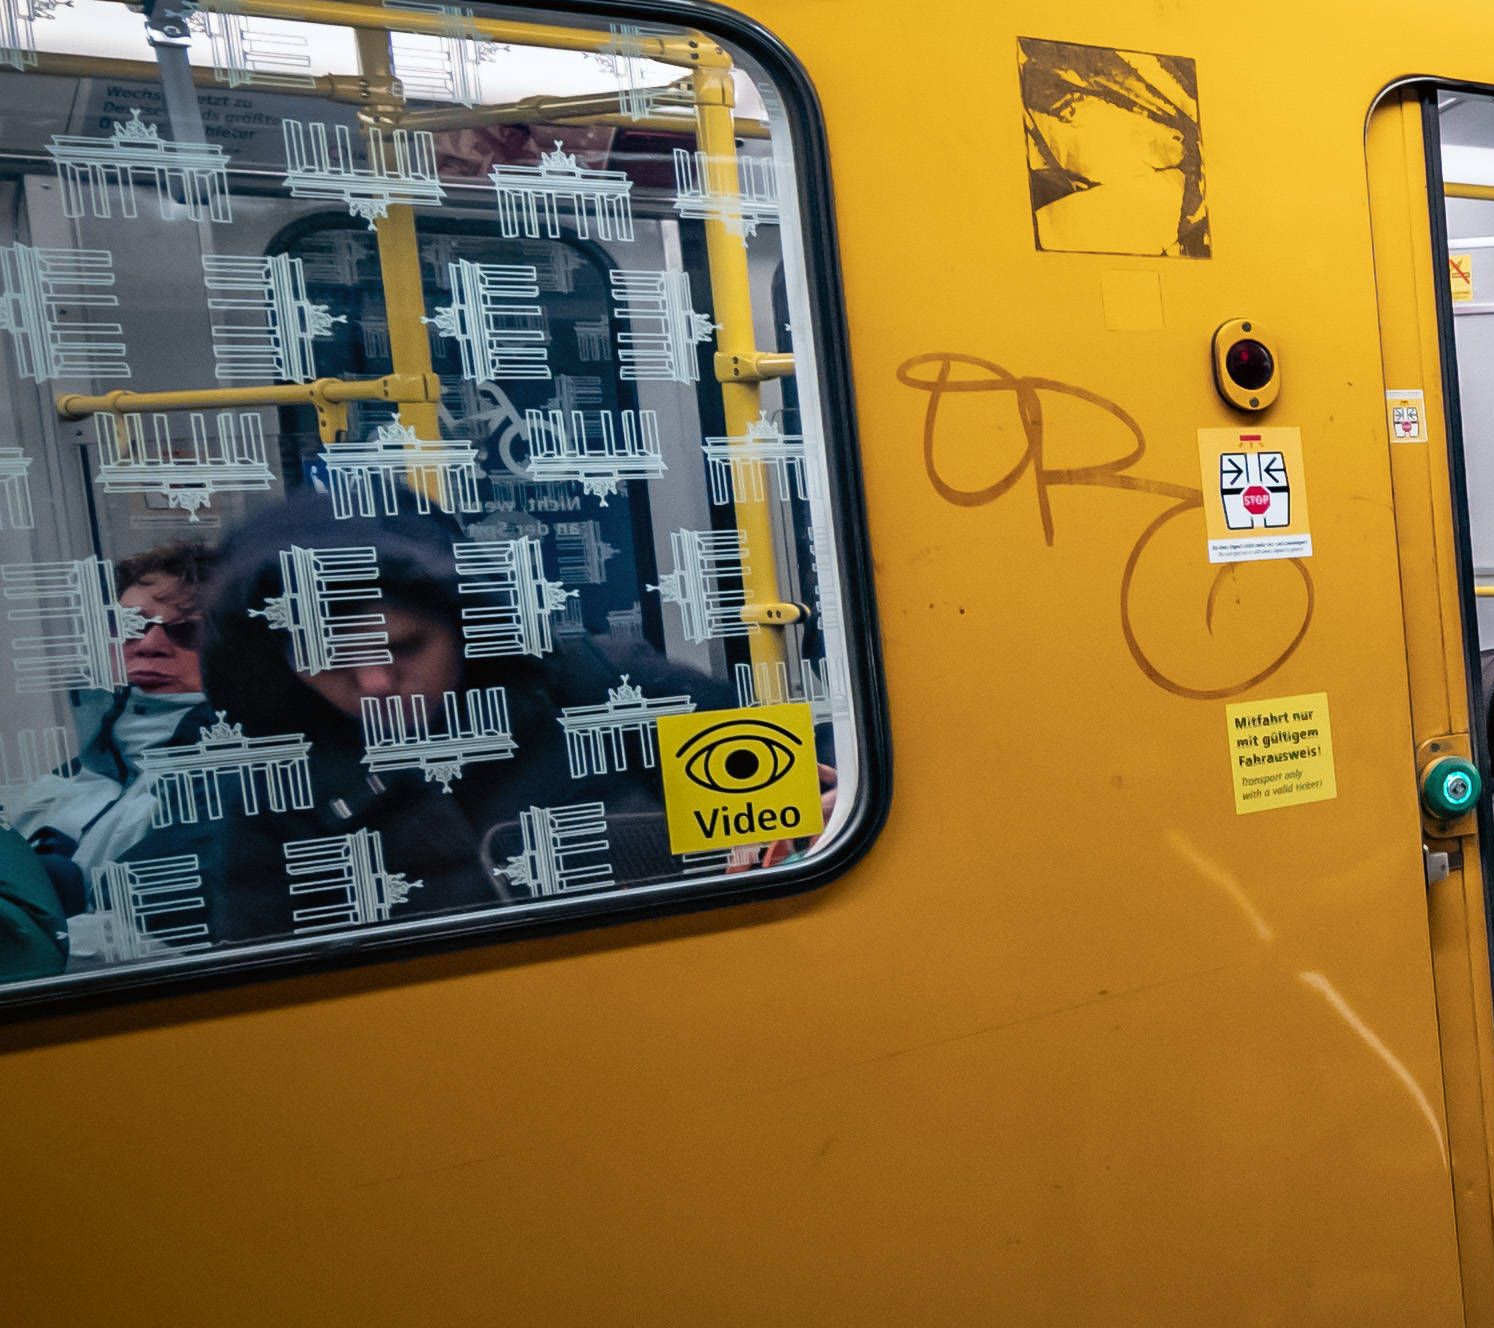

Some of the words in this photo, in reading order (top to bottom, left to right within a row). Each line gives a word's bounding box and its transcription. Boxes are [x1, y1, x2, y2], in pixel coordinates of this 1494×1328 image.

[1243, 494, 1270, 506] STOP
[1234, 712, 1289, 729] Mitfahrt
[1292, 710, 1314, 722] nur
[1236, 734, 1259, 747] mit
[1262, 728, 1319, 749] gültigem
[1238, 745, 1322, 767] Fahrausweis!
[1241, 771, 1283, 787] Transport
[1284, 769, 1303, 781] only
[1242, 788, 1262, 801] with
[1264, 789, 1270, 797] a
[1273, 783, 1294, 796] valid
[693, 802, 801, 839] Video
